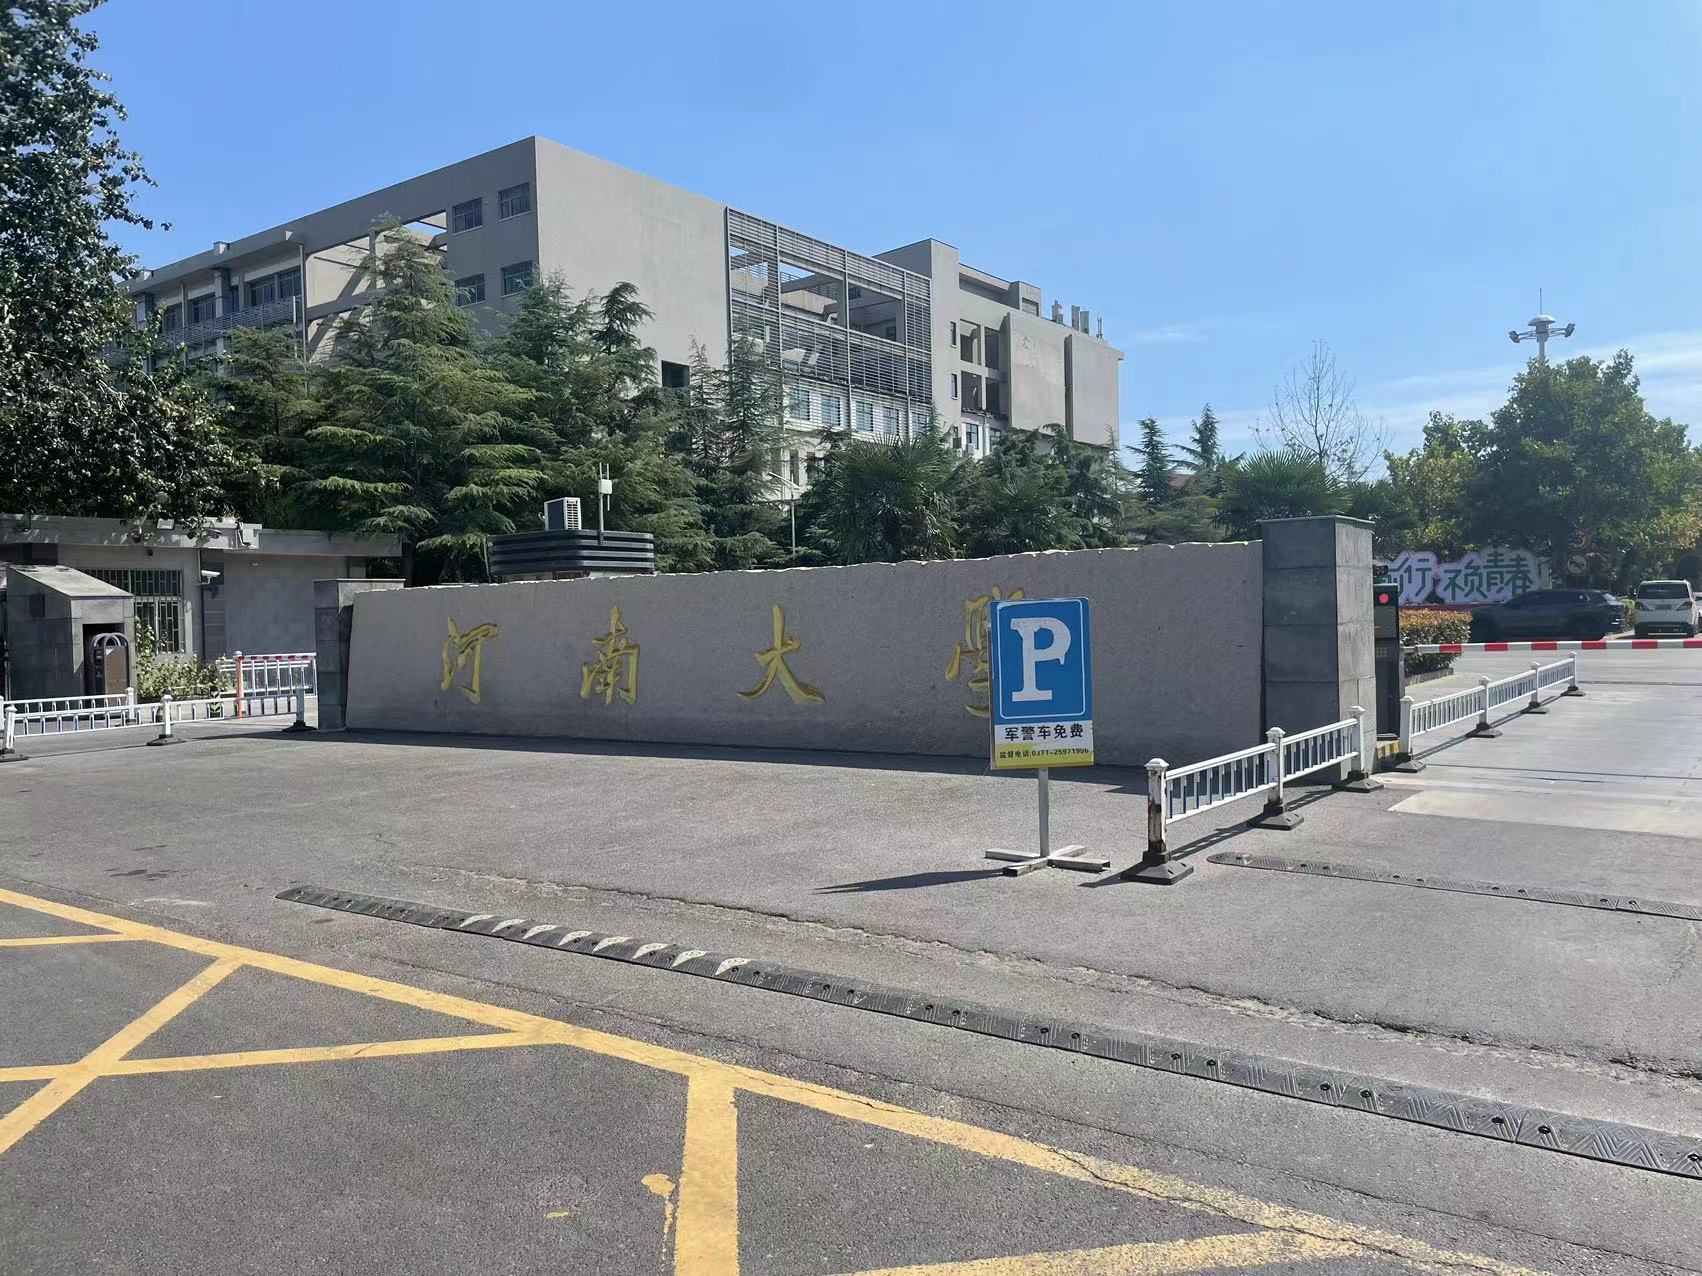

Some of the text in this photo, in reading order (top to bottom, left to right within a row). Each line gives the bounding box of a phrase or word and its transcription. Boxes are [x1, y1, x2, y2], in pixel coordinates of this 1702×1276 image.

[1011, 616, 1072, 702] P
[1004, 723, 1083, 741] 军警车免费
